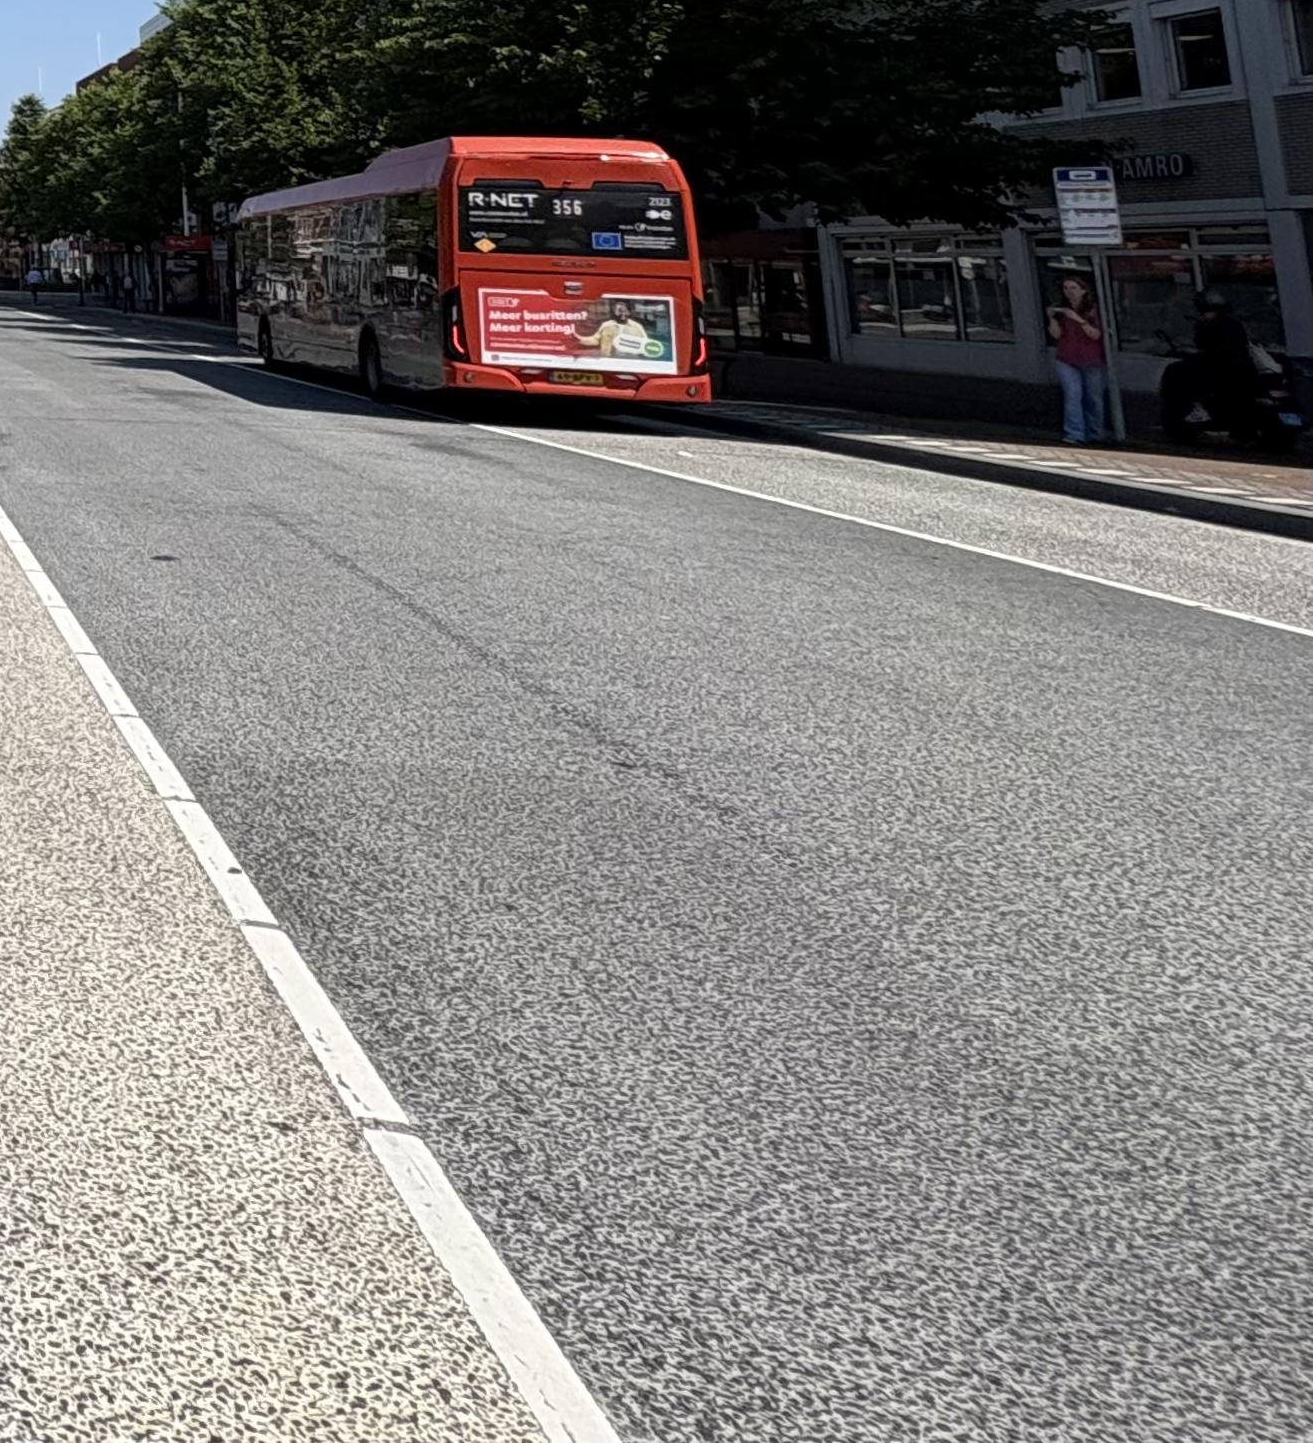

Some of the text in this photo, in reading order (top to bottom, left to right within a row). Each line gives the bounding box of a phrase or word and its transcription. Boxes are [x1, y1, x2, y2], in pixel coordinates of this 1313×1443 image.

[552, 199, 582, 215] 356
[489, 310, 522, 320] Meer
[489, 323, 523, 333] Meer
